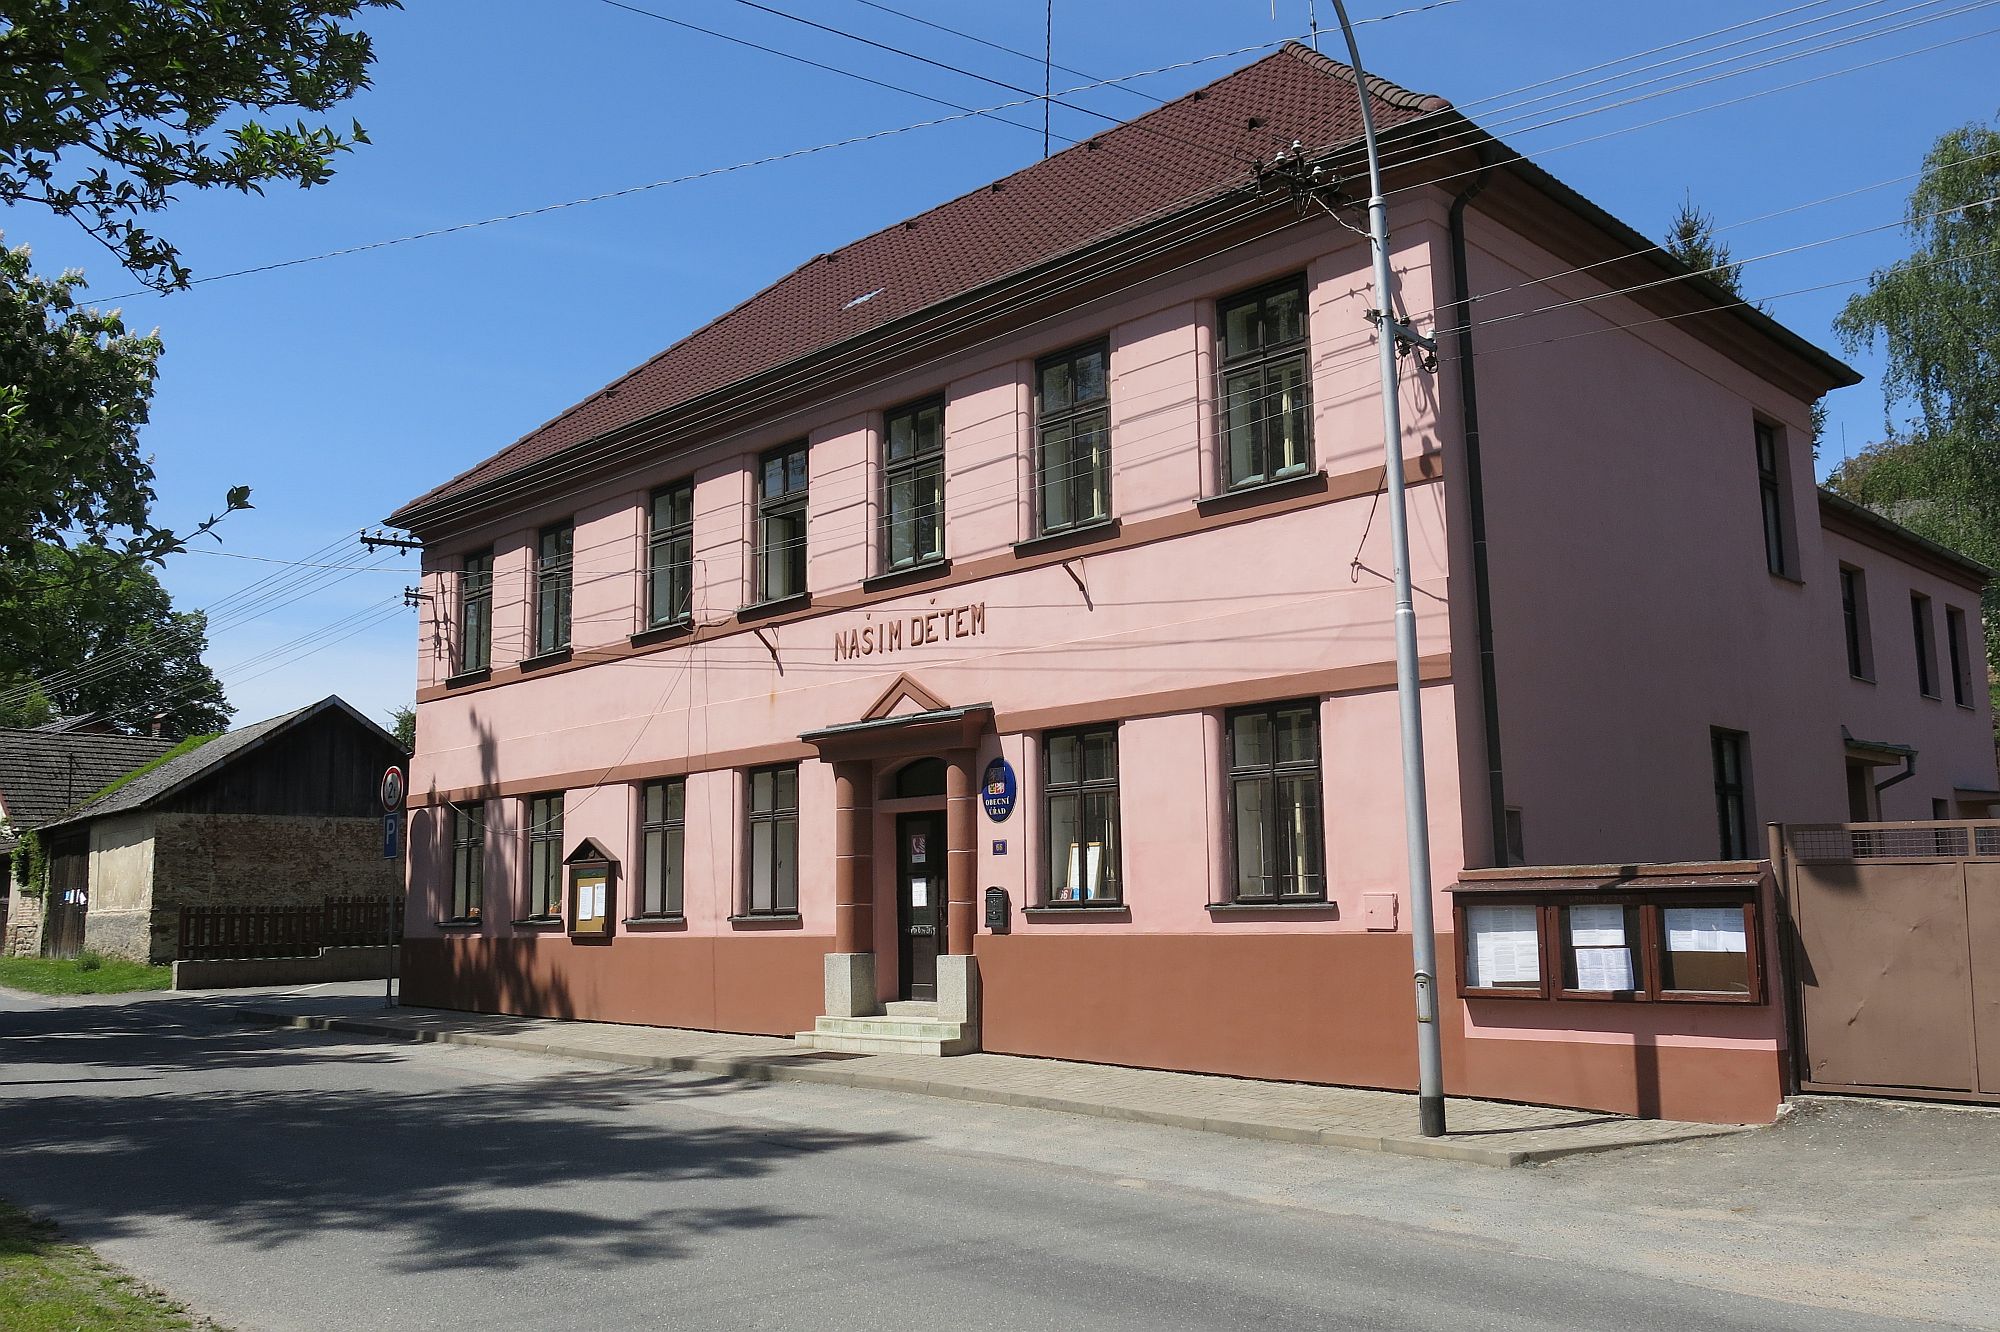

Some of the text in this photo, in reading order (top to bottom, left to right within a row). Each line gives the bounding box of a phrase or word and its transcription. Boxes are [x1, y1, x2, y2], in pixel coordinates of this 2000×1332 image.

[834, 597, 985, 662] NAŠIM DĚTEM
[985, 796, 1010, 806] OBECNÍ
[988, 806, 1006, 816] ÚŘAD
[386, 818, 395, 845] P
